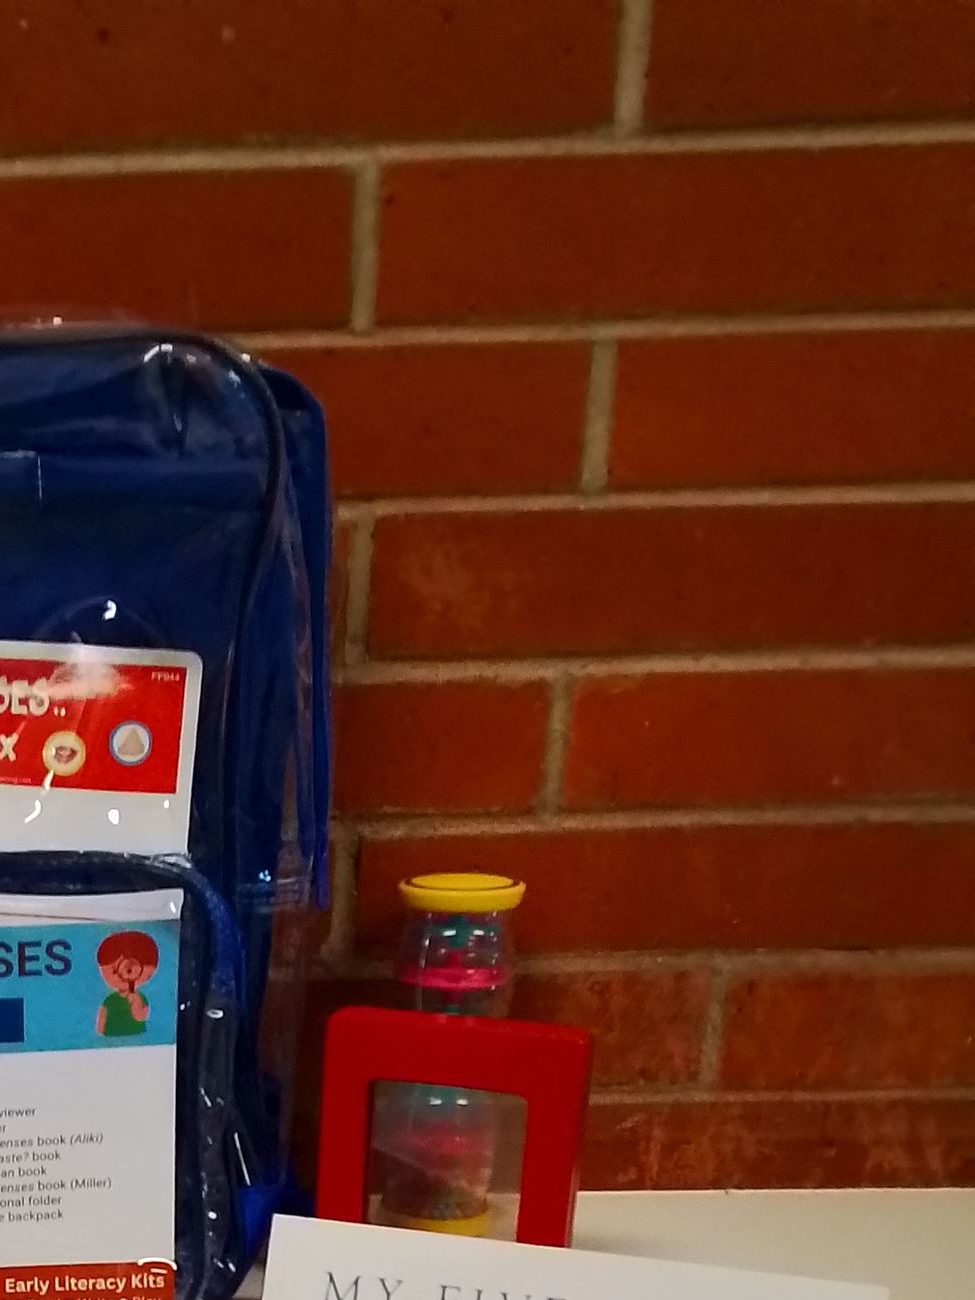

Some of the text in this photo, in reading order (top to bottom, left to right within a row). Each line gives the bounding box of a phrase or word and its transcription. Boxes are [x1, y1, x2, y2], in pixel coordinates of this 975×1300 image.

[37, 1135, 66, 1147] book
[70, 1132, 104, 1146] (Aliki)
[32, 1150, 61, 1162] book
[18, 1165, 47, 1177] book
[38, 1179, 67, 1191] book
[70, 1176, 112, 1190] (Miller)
[28, 1195, 63, 1207] folder
[8, 1209, 63, 1223] backpack
[5, 1273, 165, 1295] Early Literacy Kits
